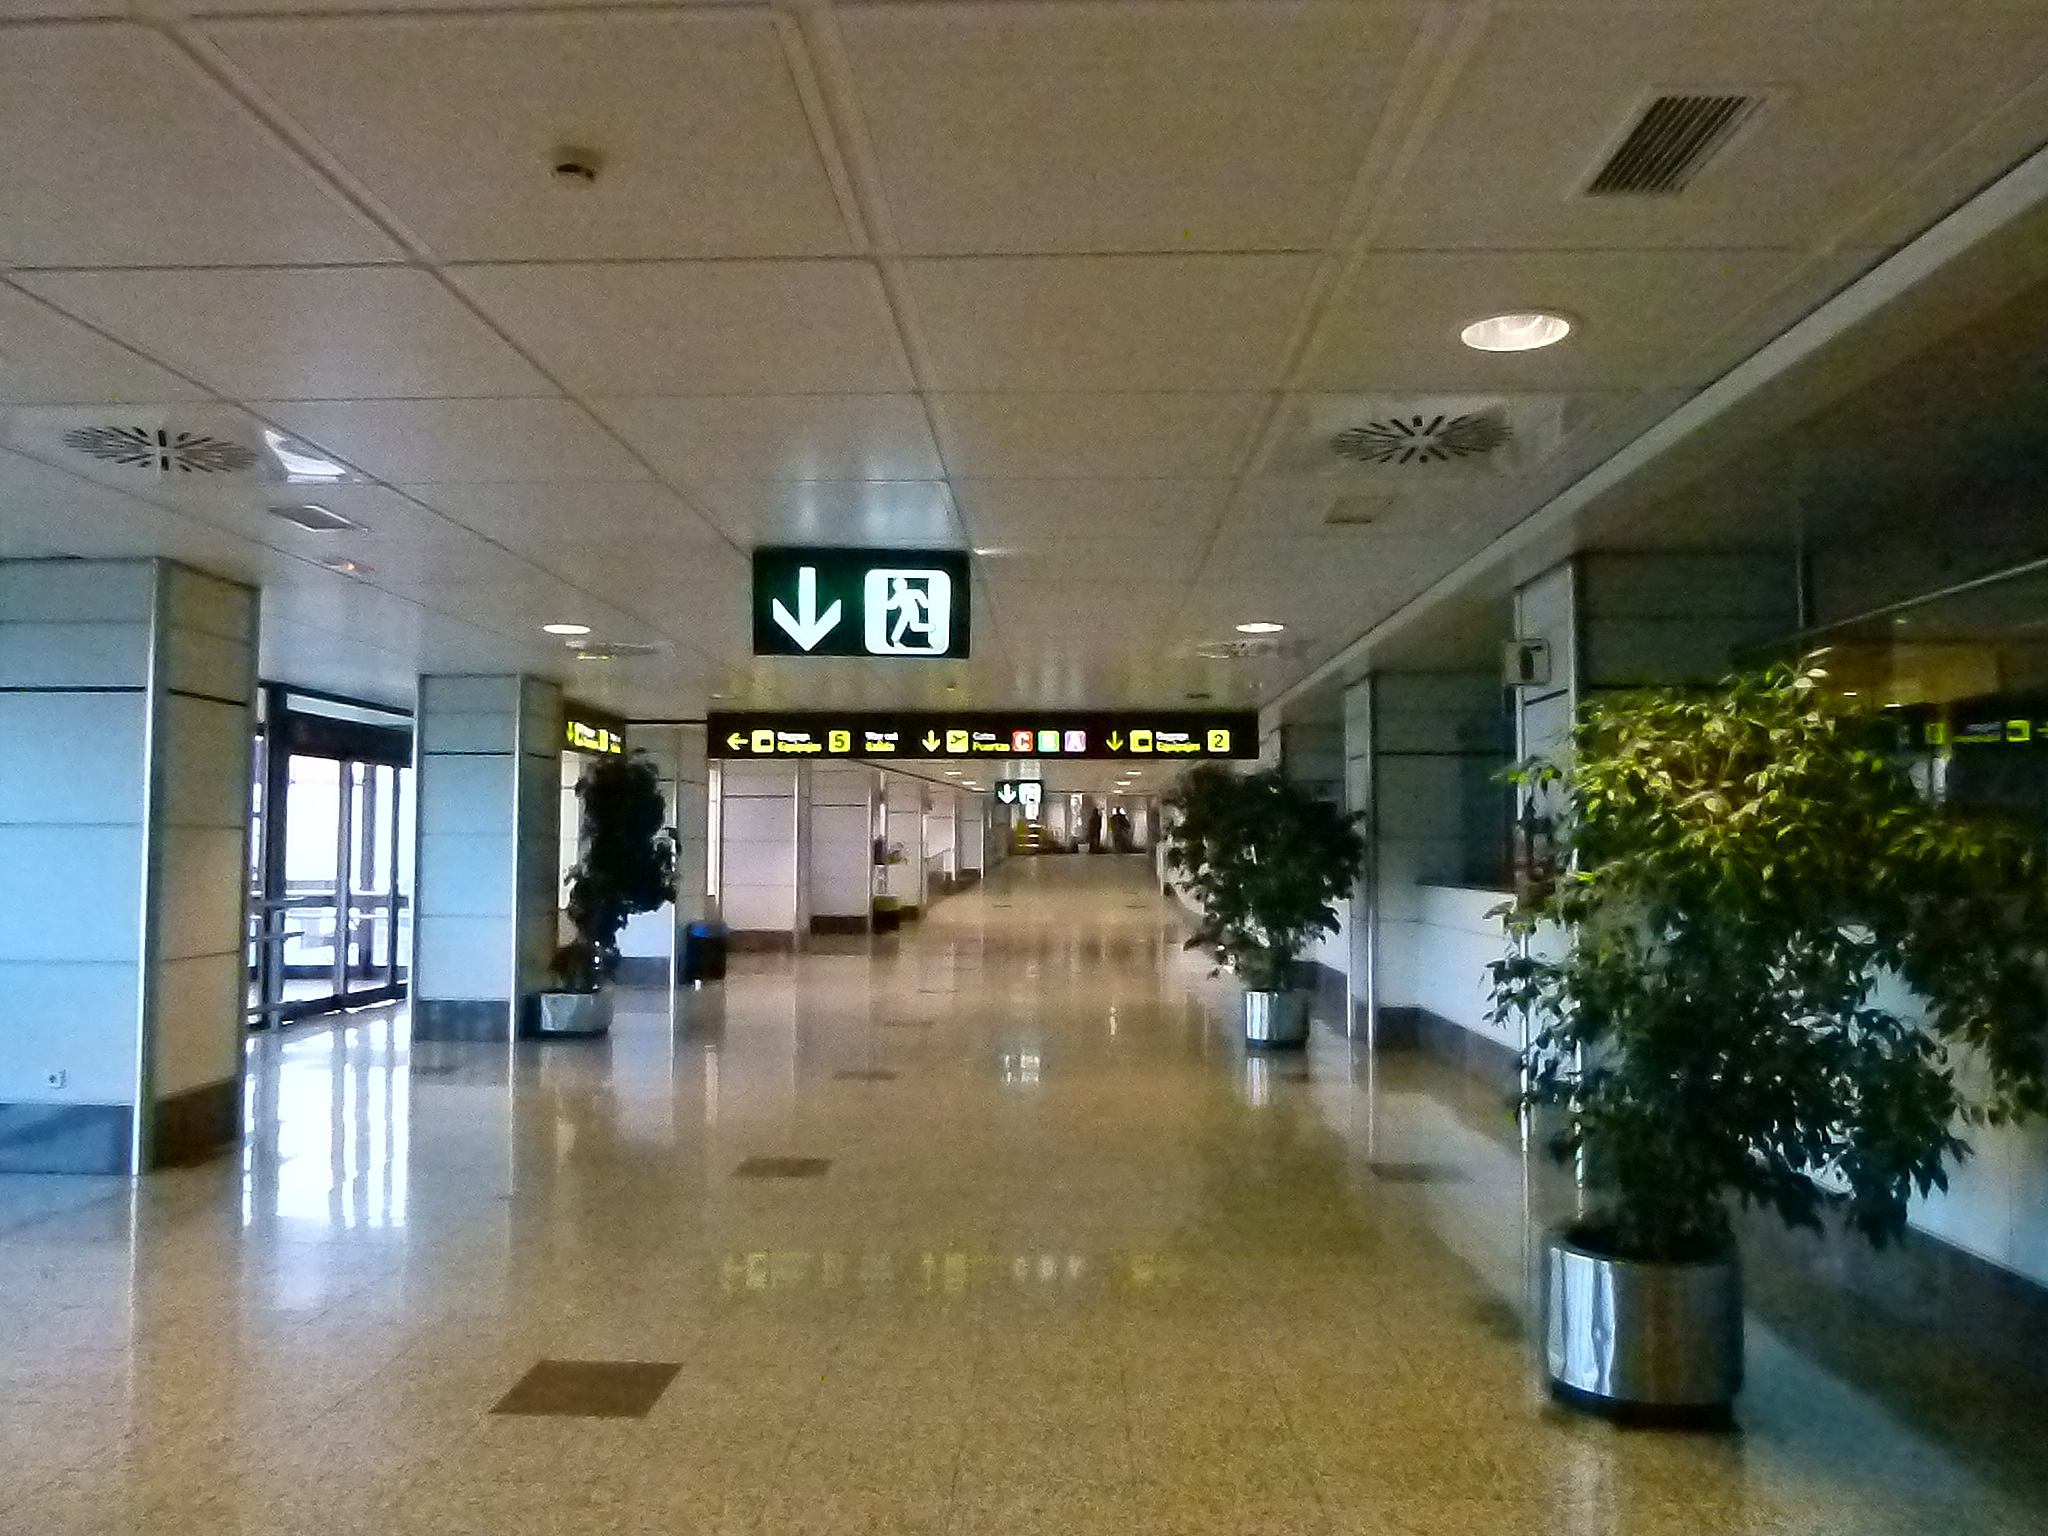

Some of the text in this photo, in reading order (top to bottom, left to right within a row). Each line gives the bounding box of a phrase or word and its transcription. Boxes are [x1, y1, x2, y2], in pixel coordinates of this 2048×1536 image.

[834, 733, 845, 749] 5
[1014, 732, 1031, 751] C
[1213, 733, 1224, 749] 2
